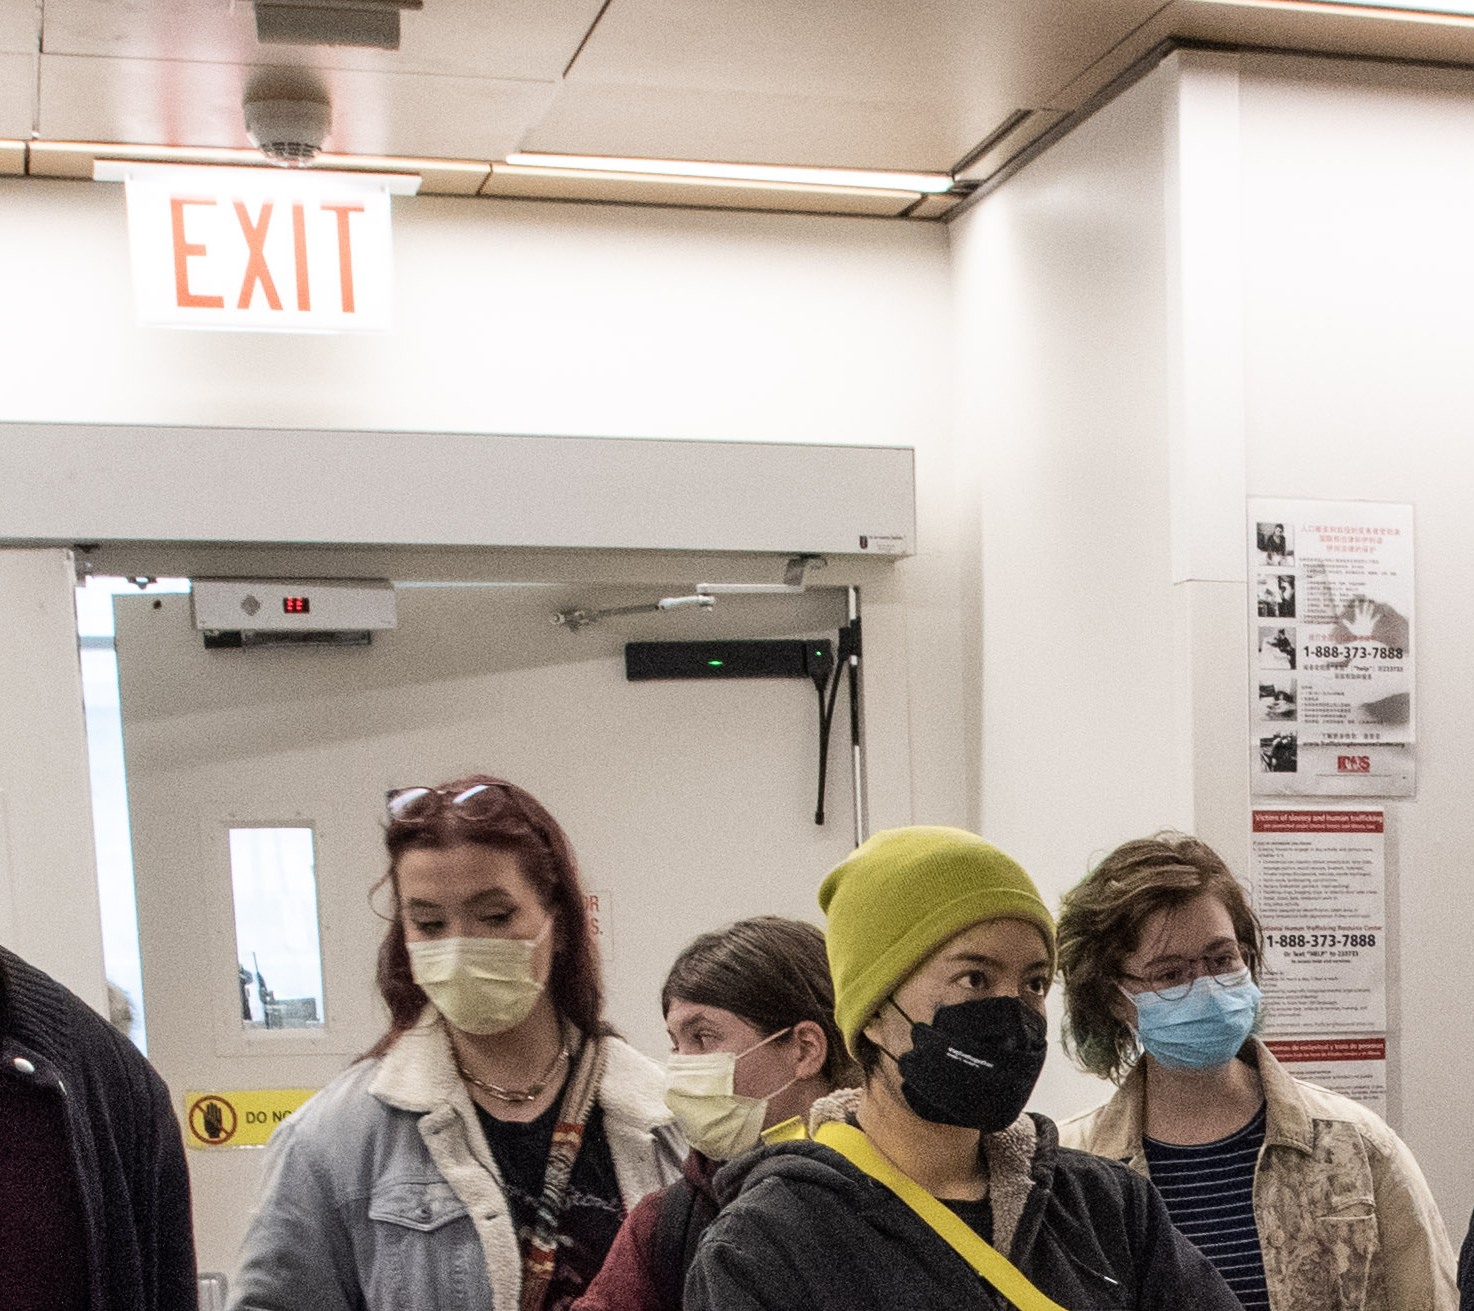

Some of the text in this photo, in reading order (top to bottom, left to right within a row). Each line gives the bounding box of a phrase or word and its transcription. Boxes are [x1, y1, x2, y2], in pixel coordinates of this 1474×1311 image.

[170, 192, 365, 314] EXIT
[1303, 646, 1404, 659] 1-888-373-7888
[1280, 813, 1287, 821] of
[1267, 934, 1376, 948] 1-888-373-7888
[245, 1111, 267, 1124] DO
